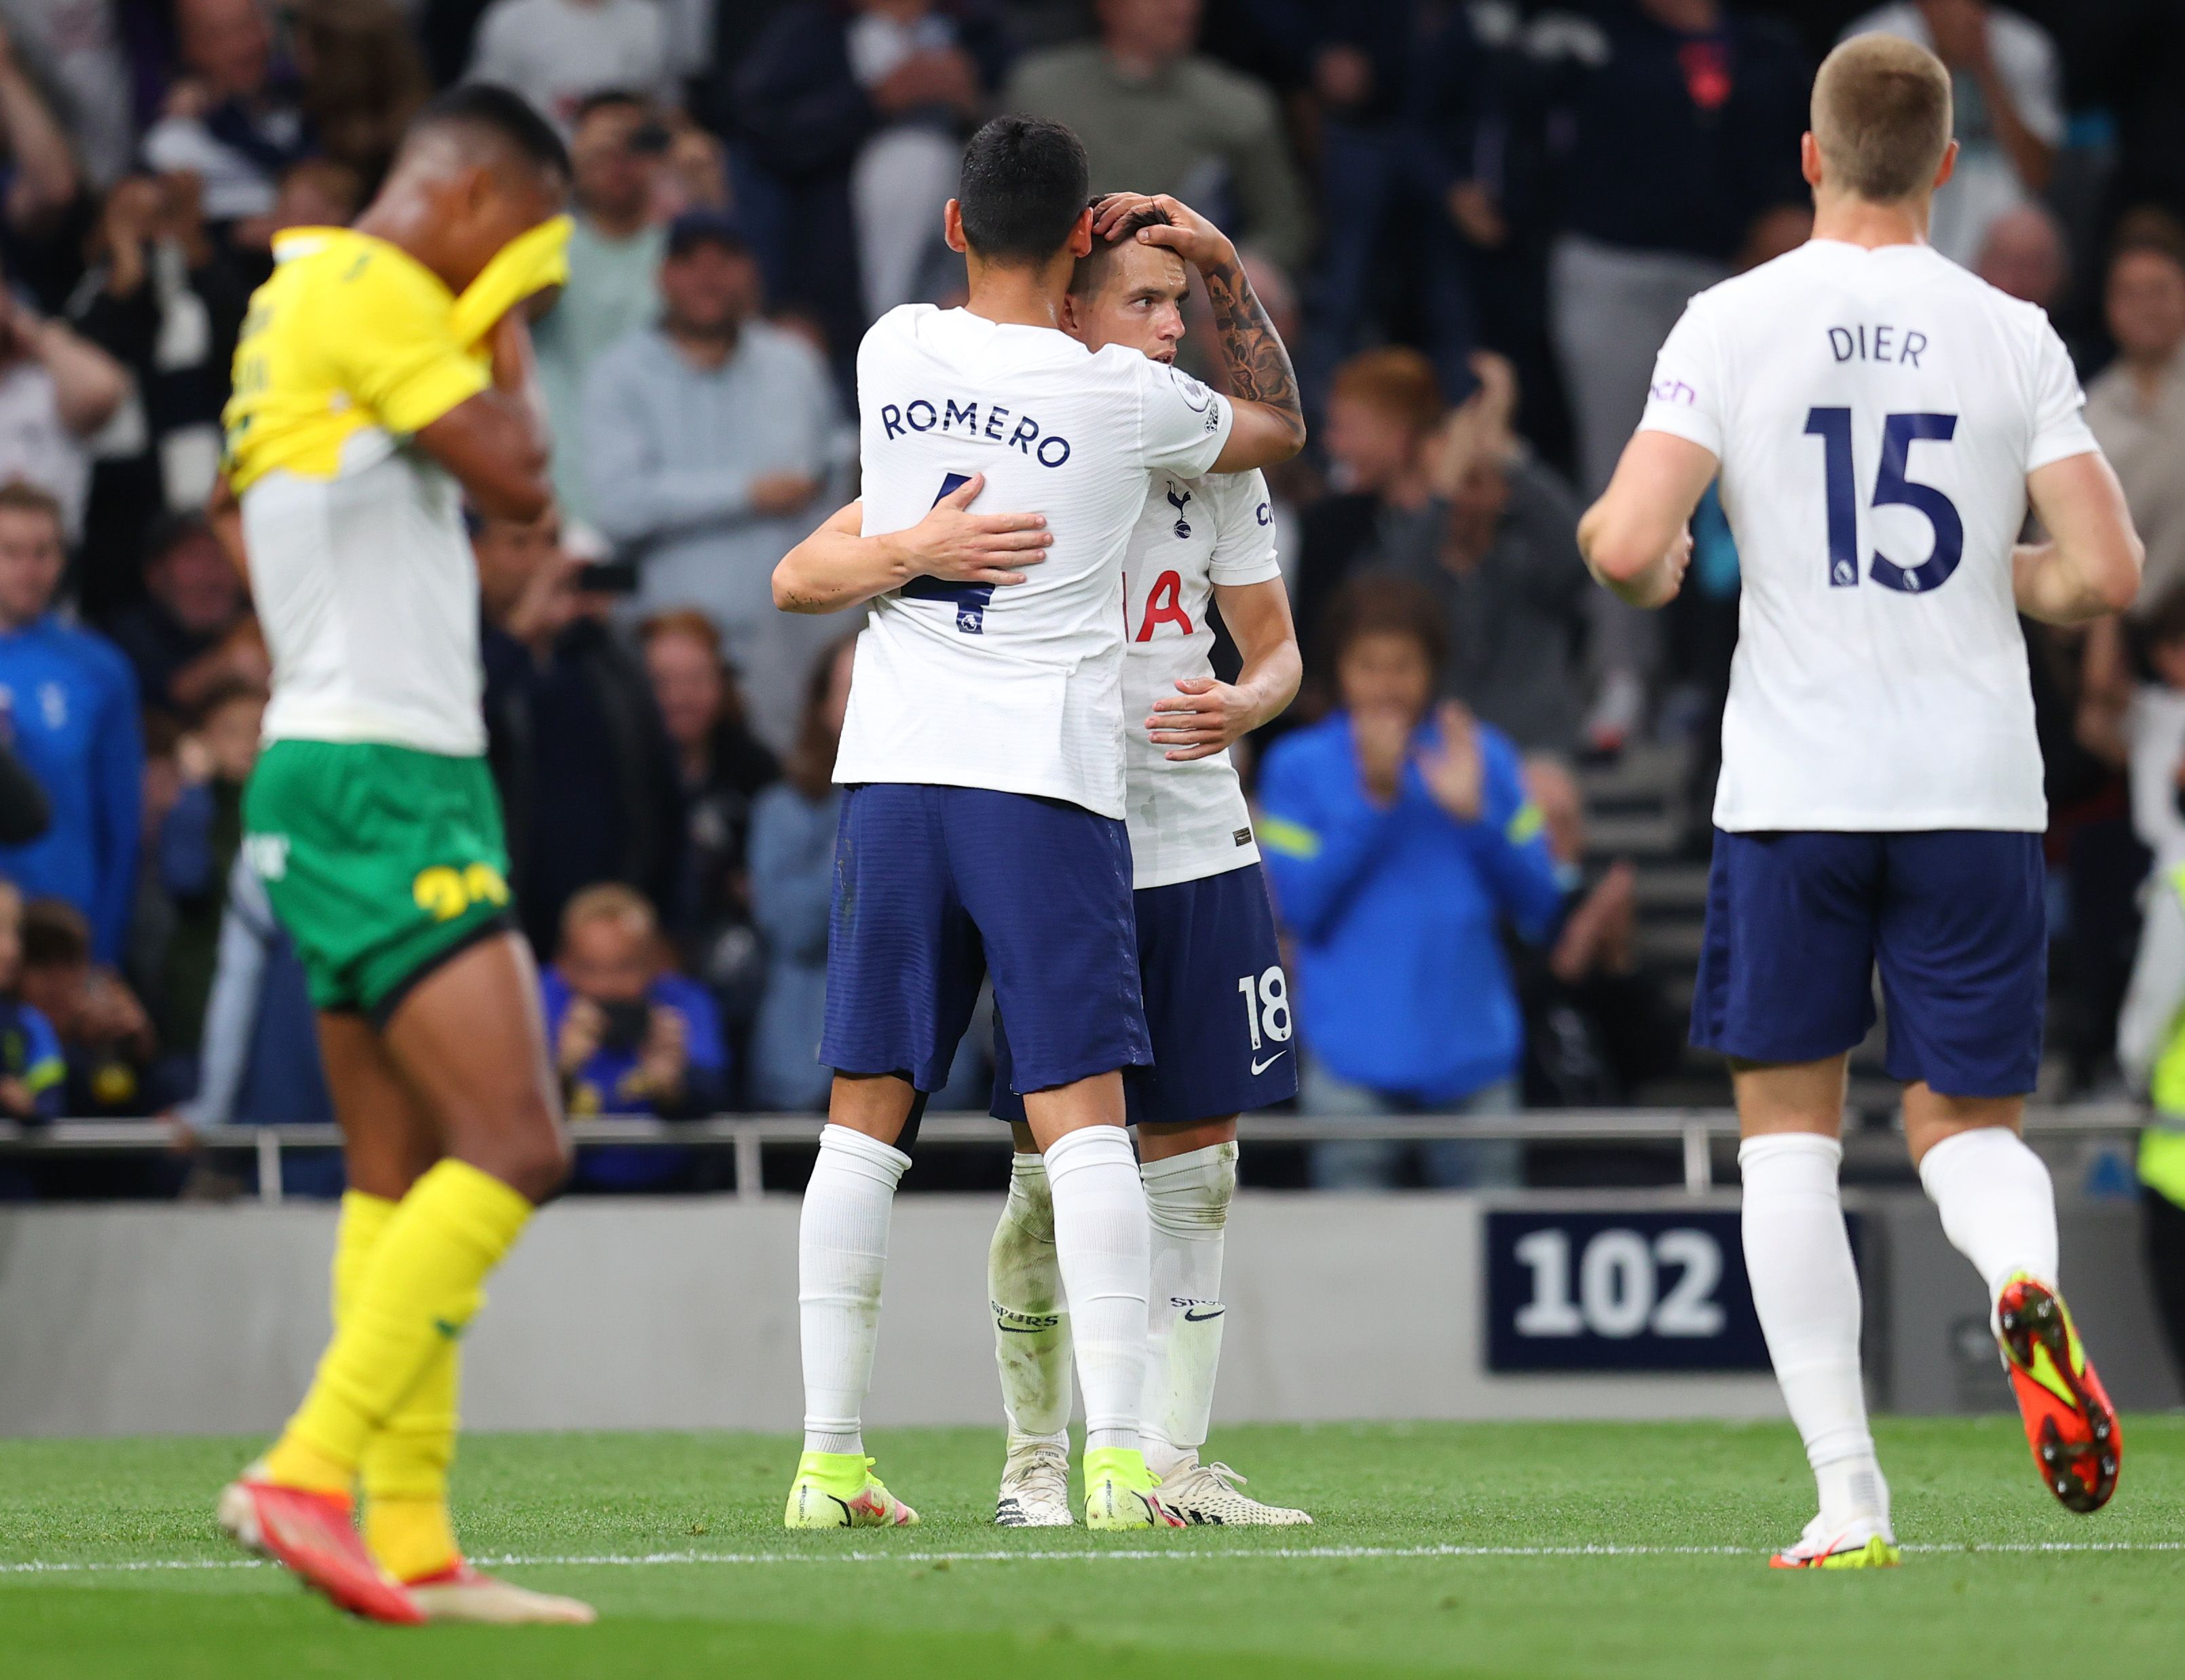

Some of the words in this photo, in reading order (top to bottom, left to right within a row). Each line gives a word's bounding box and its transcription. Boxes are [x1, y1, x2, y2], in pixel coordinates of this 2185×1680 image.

[1828, 324, 1928, 368] DIER
[881, 398, 1071, 468] ROMERO
[1803, 407, 1964, 595] 15
[1238, 965, 1292, 1051] 18
[991, 1300, 1059, 1327] SPURS
[1514, 1227, 1727, 1339] 102
